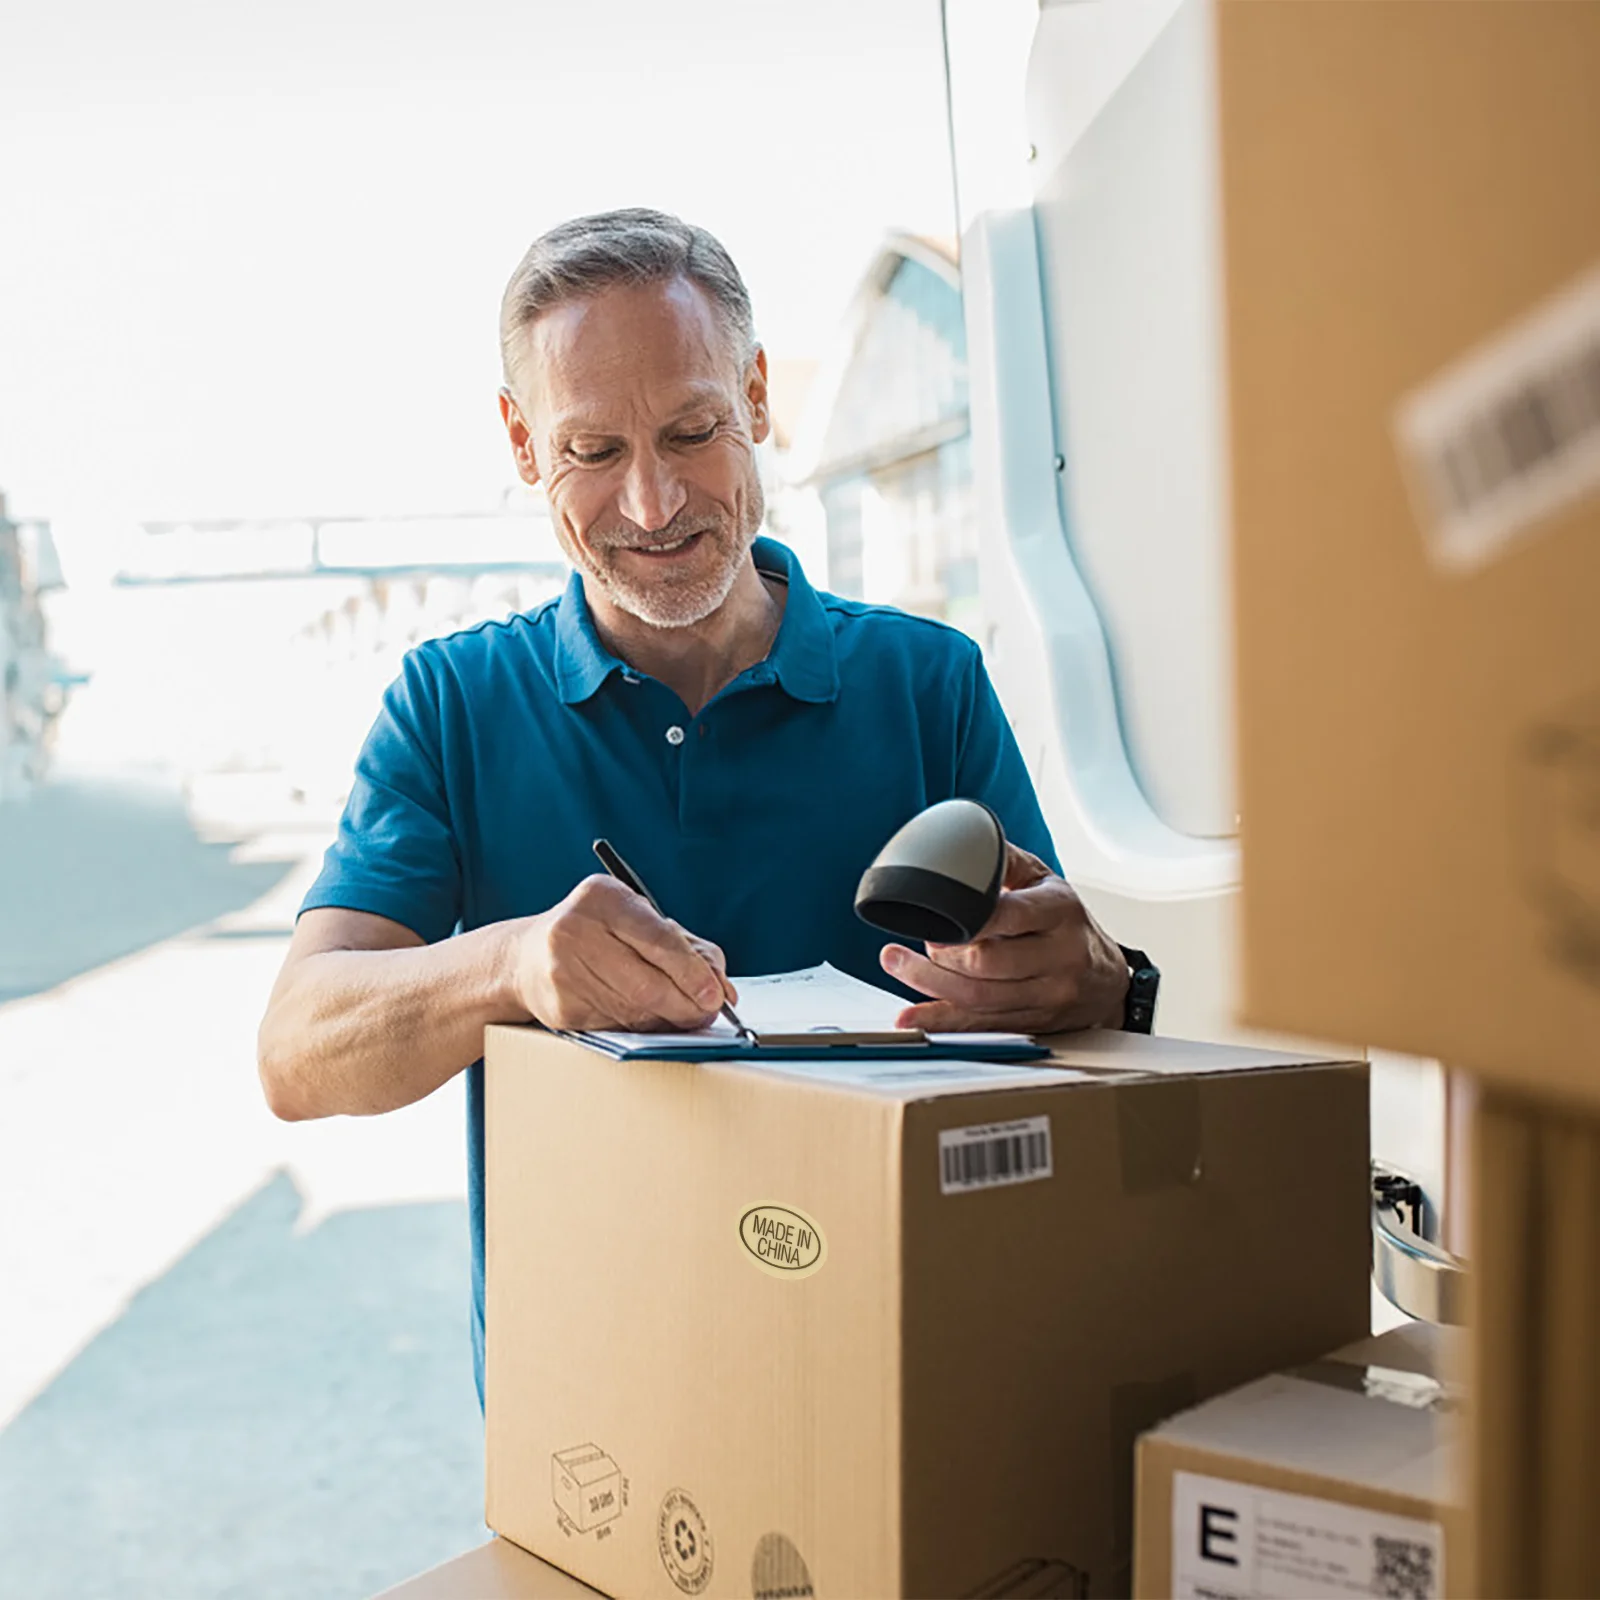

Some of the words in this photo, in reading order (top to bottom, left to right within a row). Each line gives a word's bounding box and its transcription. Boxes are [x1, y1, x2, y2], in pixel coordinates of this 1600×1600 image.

[752, 1214, 795, 1245] MADE
[797, 1228, 812, 1250] IN
[757, 1237, 800, 1267] CHINA
[1199, 1503, 1239, 1567] E
